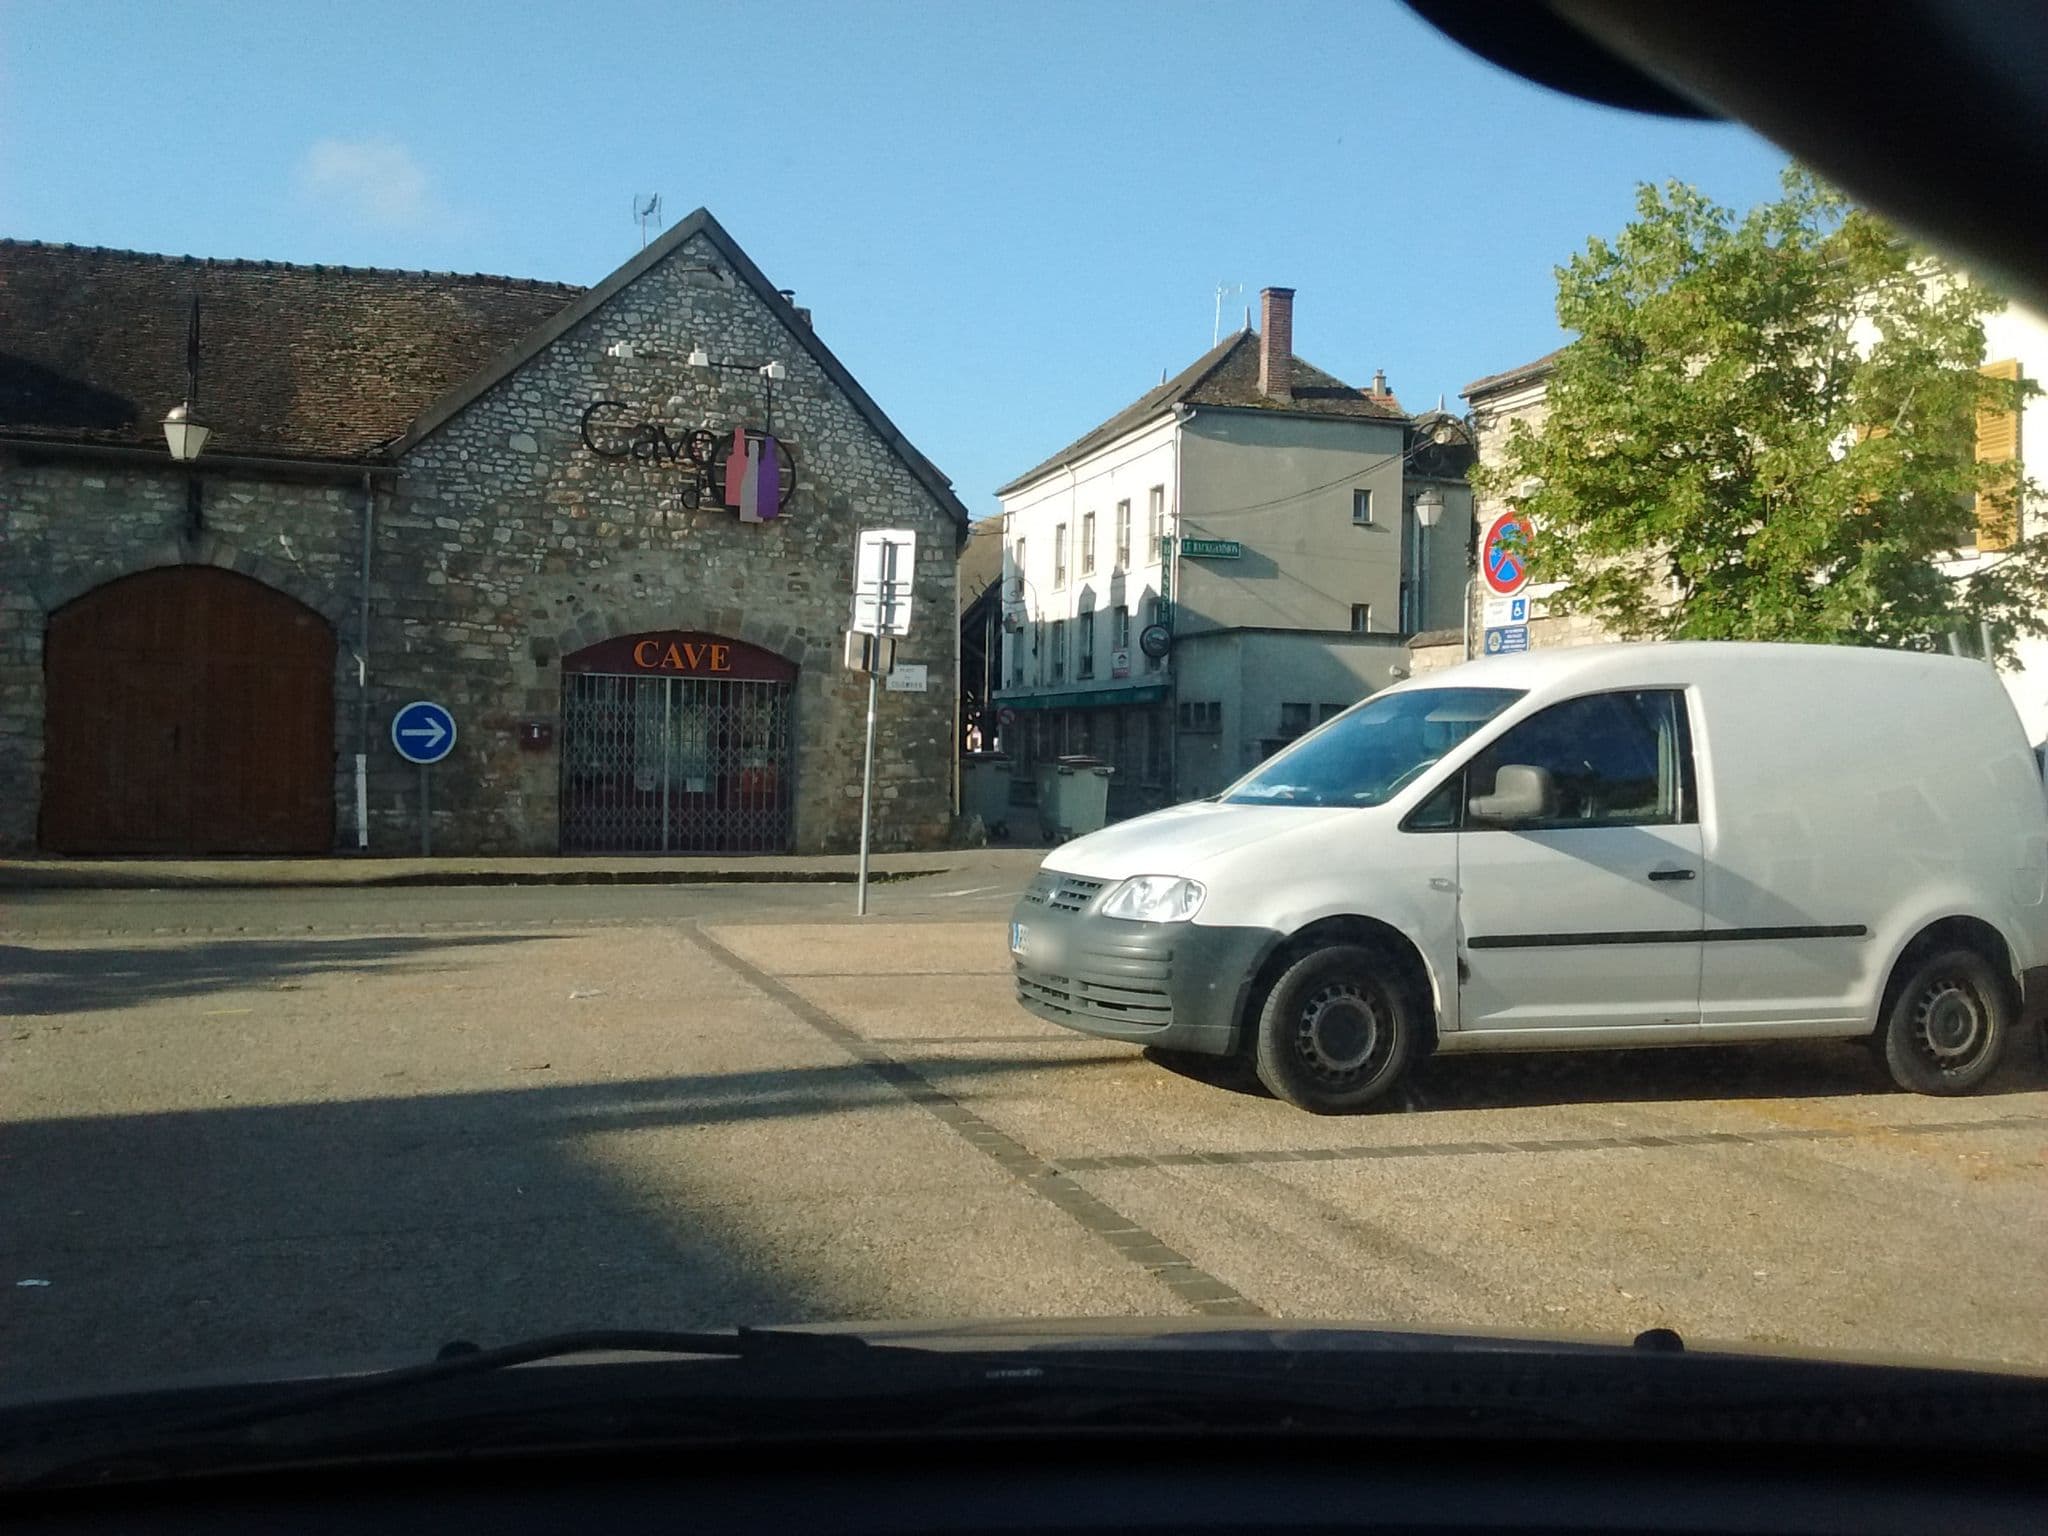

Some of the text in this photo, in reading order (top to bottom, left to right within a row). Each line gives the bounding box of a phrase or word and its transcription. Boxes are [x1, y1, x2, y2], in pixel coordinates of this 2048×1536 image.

[581, 400, 716, 464] Cave
[1161, 543, 1171, 631] BRASSER
[633, 640, 731, 671] CAVE
